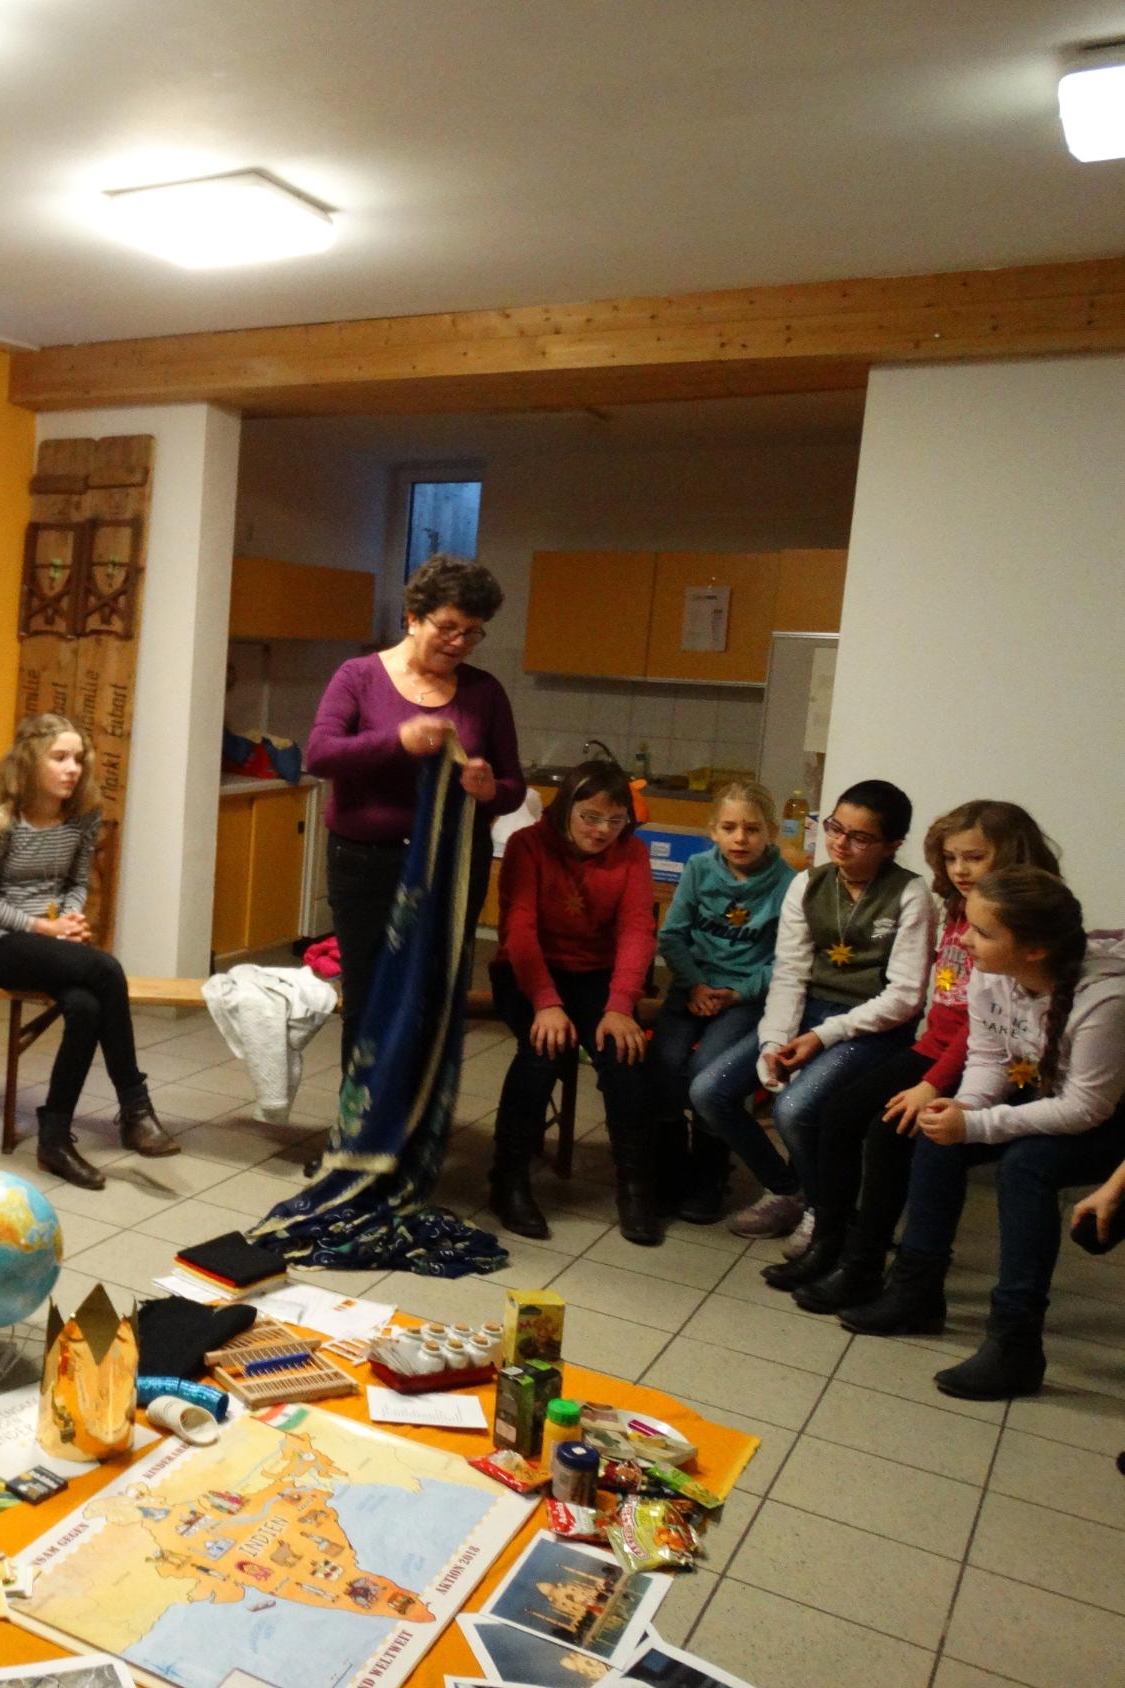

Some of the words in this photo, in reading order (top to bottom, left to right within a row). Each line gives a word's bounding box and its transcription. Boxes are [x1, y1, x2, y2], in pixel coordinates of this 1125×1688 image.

[57, 1521, 90, 1547] GEGEN
[238, 1514, 289, 1557] INDIEN
[435, 1563, 465, 1596] AKTION
[458, 1545, 481, 1570] 2018
[369, 1629, 414, 1677] WELTWEIT
